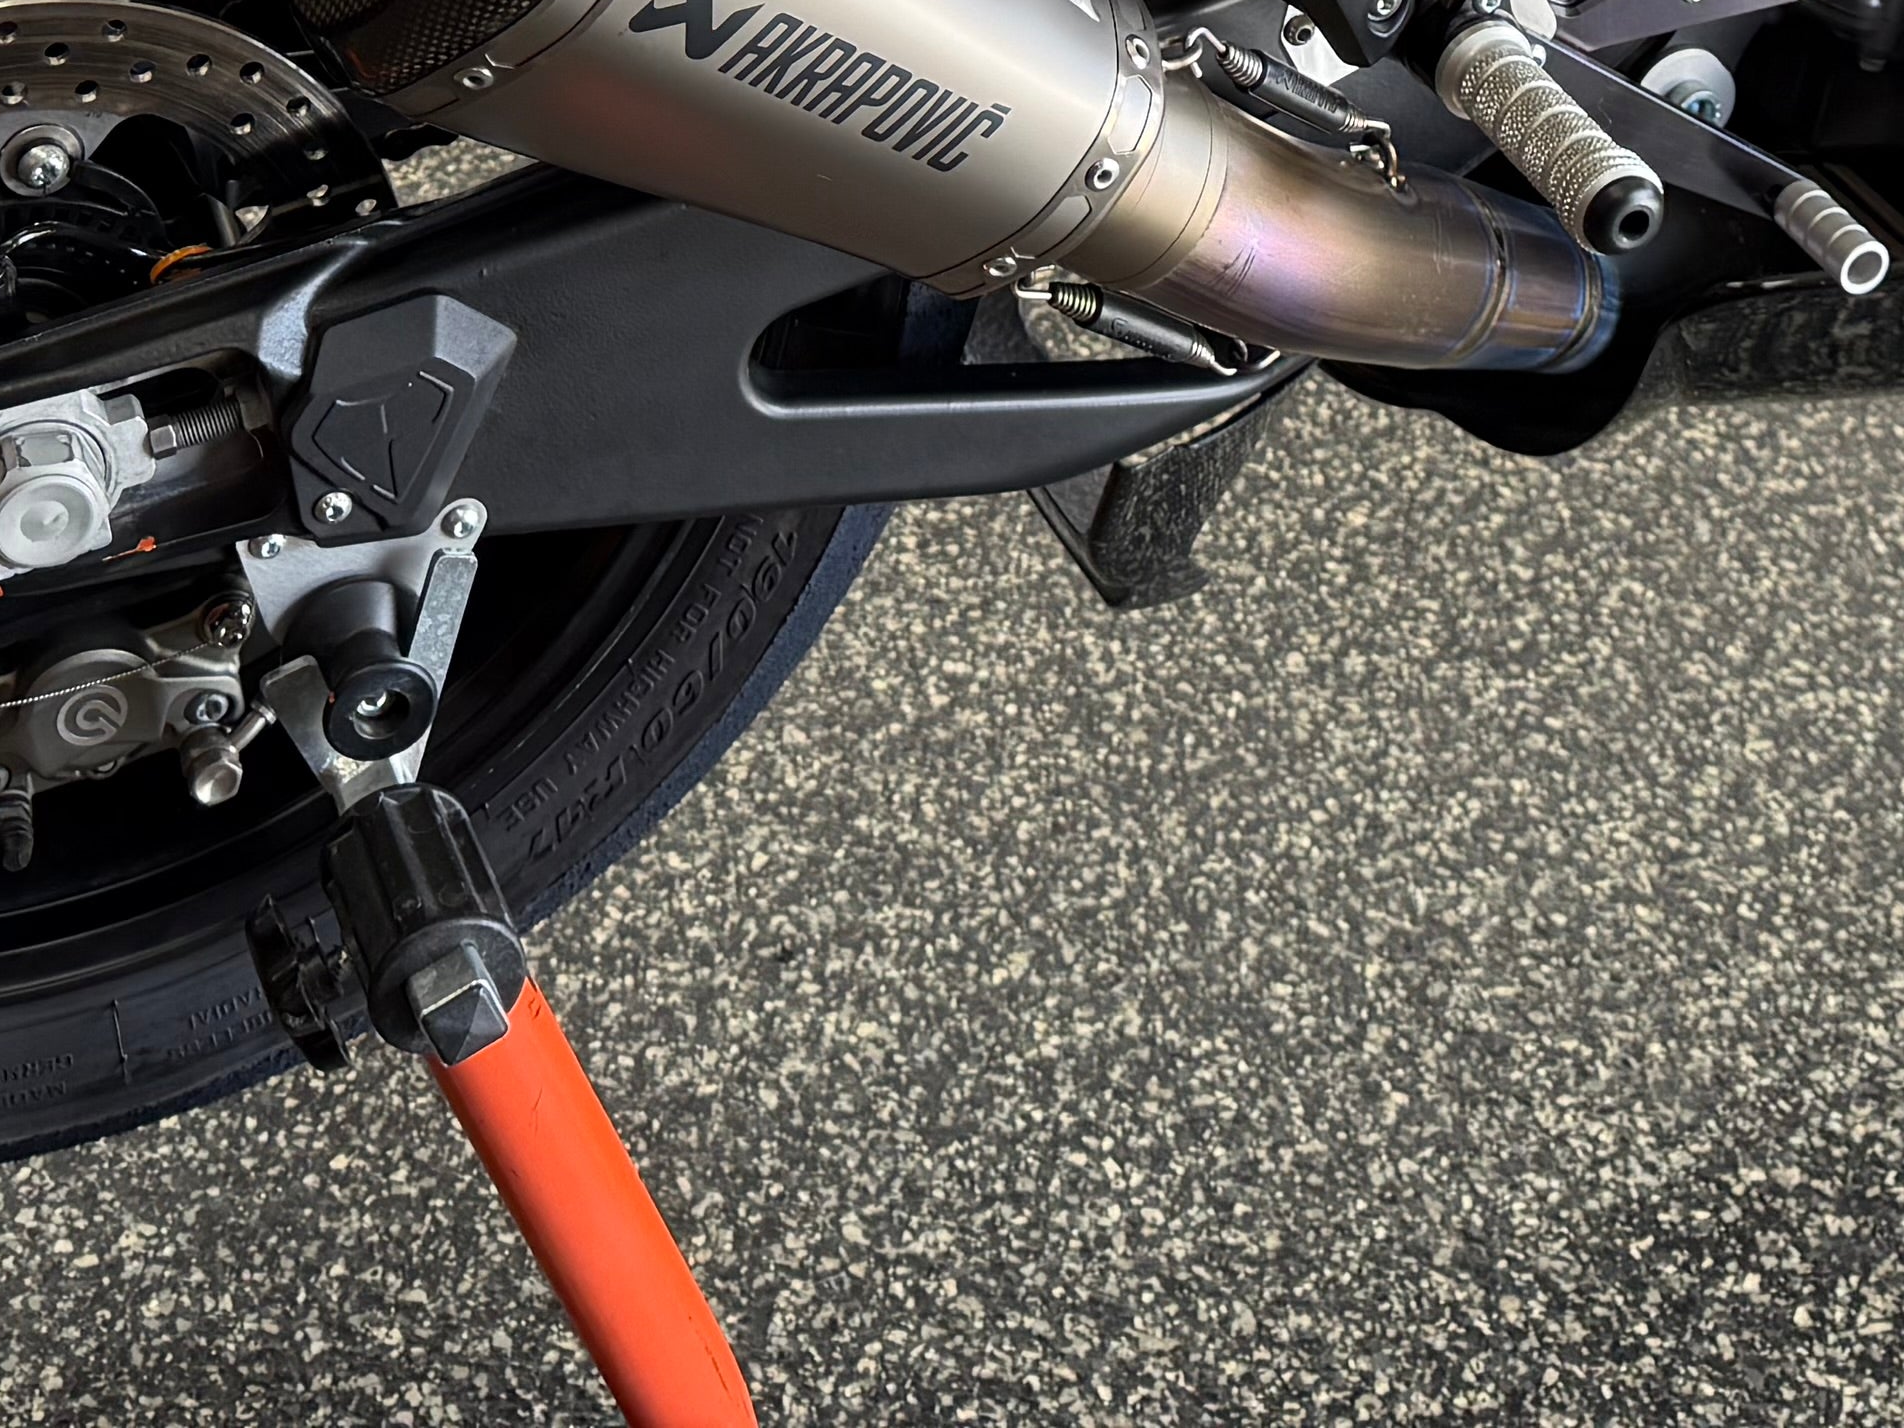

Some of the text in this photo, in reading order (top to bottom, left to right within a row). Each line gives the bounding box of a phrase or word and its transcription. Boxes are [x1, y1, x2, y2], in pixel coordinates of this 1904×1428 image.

[504, 512, 765, 831] NOT FOR HIGHWAY USE
